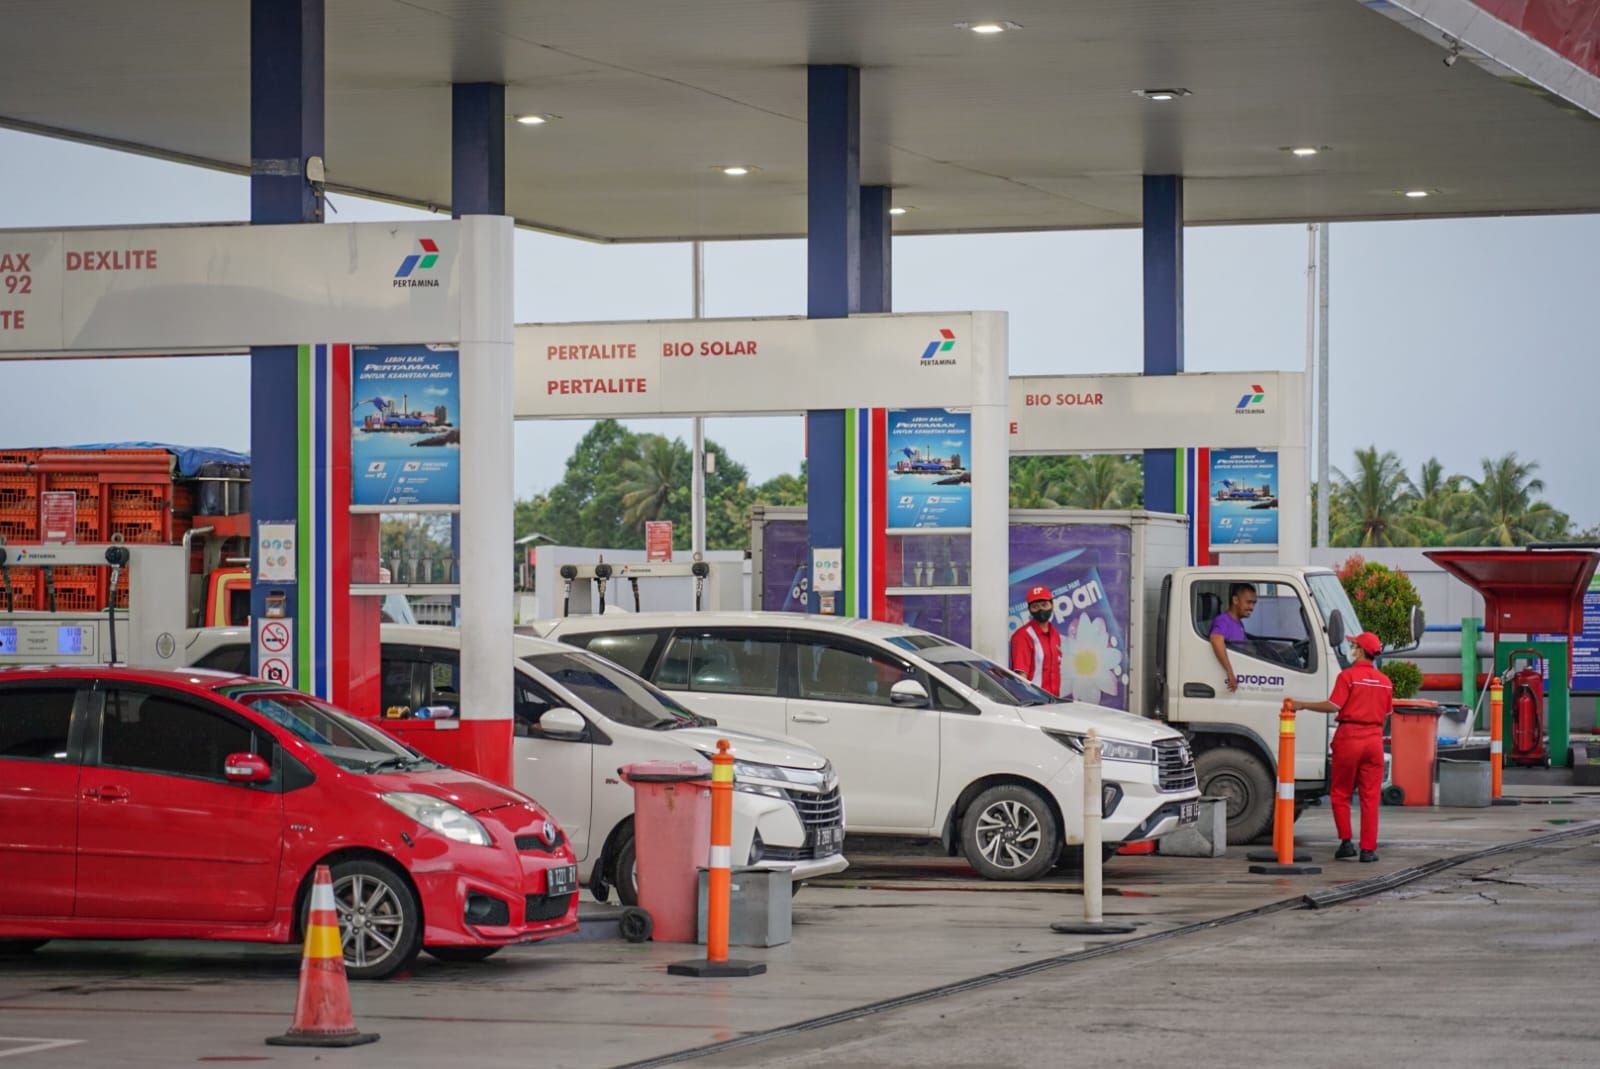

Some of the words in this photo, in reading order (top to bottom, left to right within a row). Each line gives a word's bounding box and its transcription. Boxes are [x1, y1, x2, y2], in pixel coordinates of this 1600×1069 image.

[0, 252, 31, 272] AX
[66, 250, 157, 271] DEXLITE
[5, 274, 32, 294] 92
[393, 279, 440, 288] PERTAMINA
[0, 310, 25, 330] TE
[547, 344, 637, 360] PERTALITE
[663, 342, 694, 357] BIO
[700, 341, 758, 356] SOLAR
[547, 378, 647, 395] PERTALITE
[1025, 394, 1052, 406] BIO
[1056, 393, 1104, 406] SOLAR
[1236, 674, 1284, 686] propan
